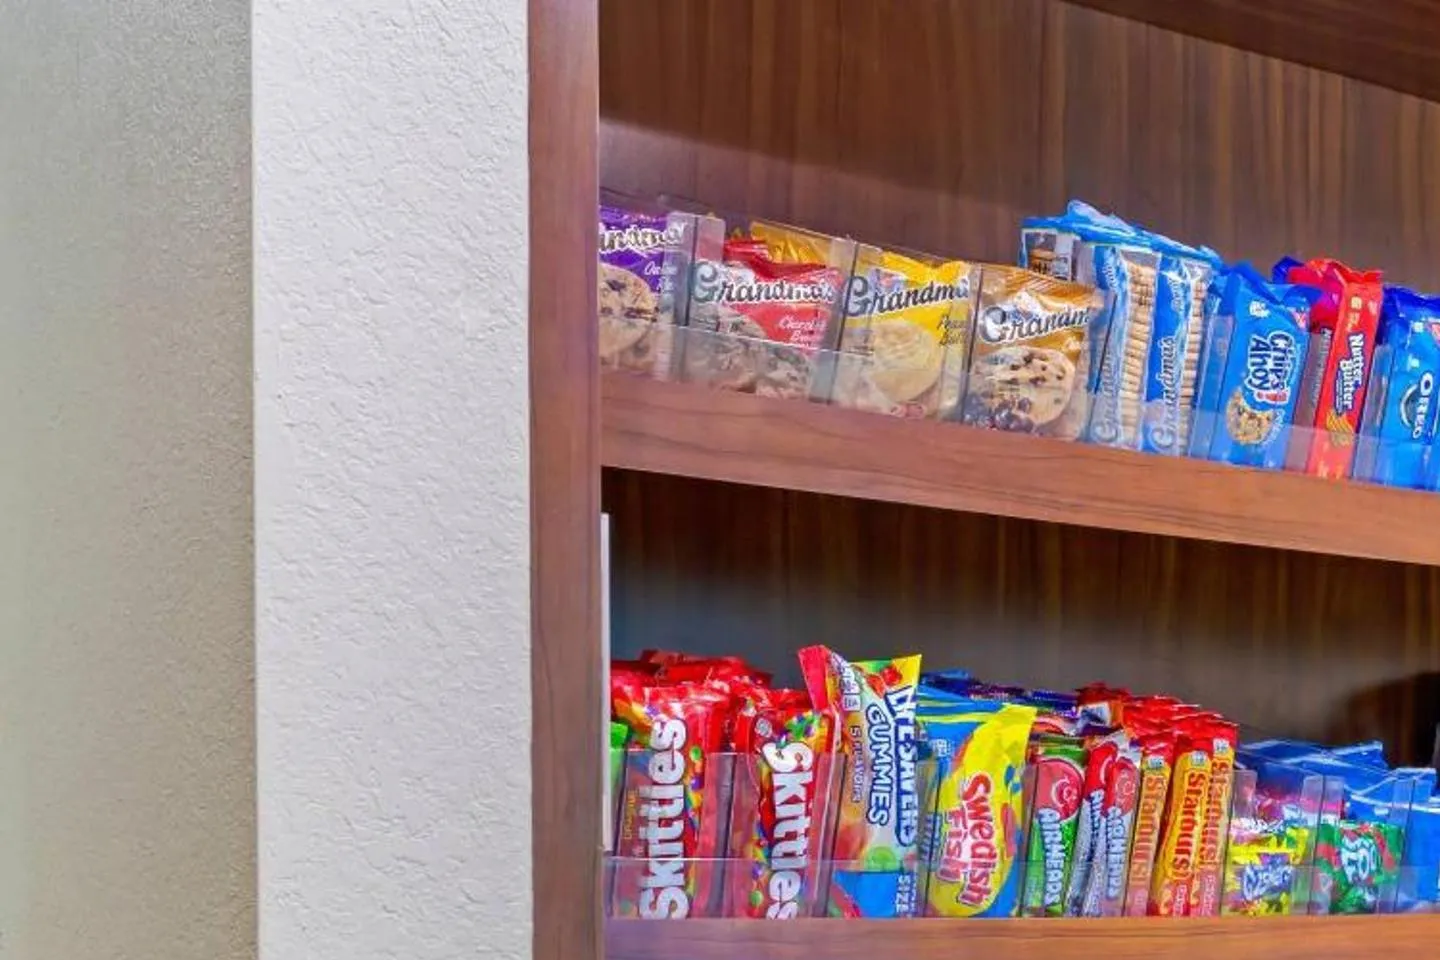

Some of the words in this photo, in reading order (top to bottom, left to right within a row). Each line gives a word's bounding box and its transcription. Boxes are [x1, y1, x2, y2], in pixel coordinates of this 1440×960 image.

[1411, 372, 1434, 439] OREO
[638, 718, 689, 919] Skittles
[865, 703, 891, 828] GUMMIES
[1172, 770, 1204, 873] Starburst
[762, 741, 815, 919] Skittles
[936, 807, 969, 883] Fish
[956, 772, 999, 906] Swedish
[1038, 807, 1066, 906] AIRHEADS
